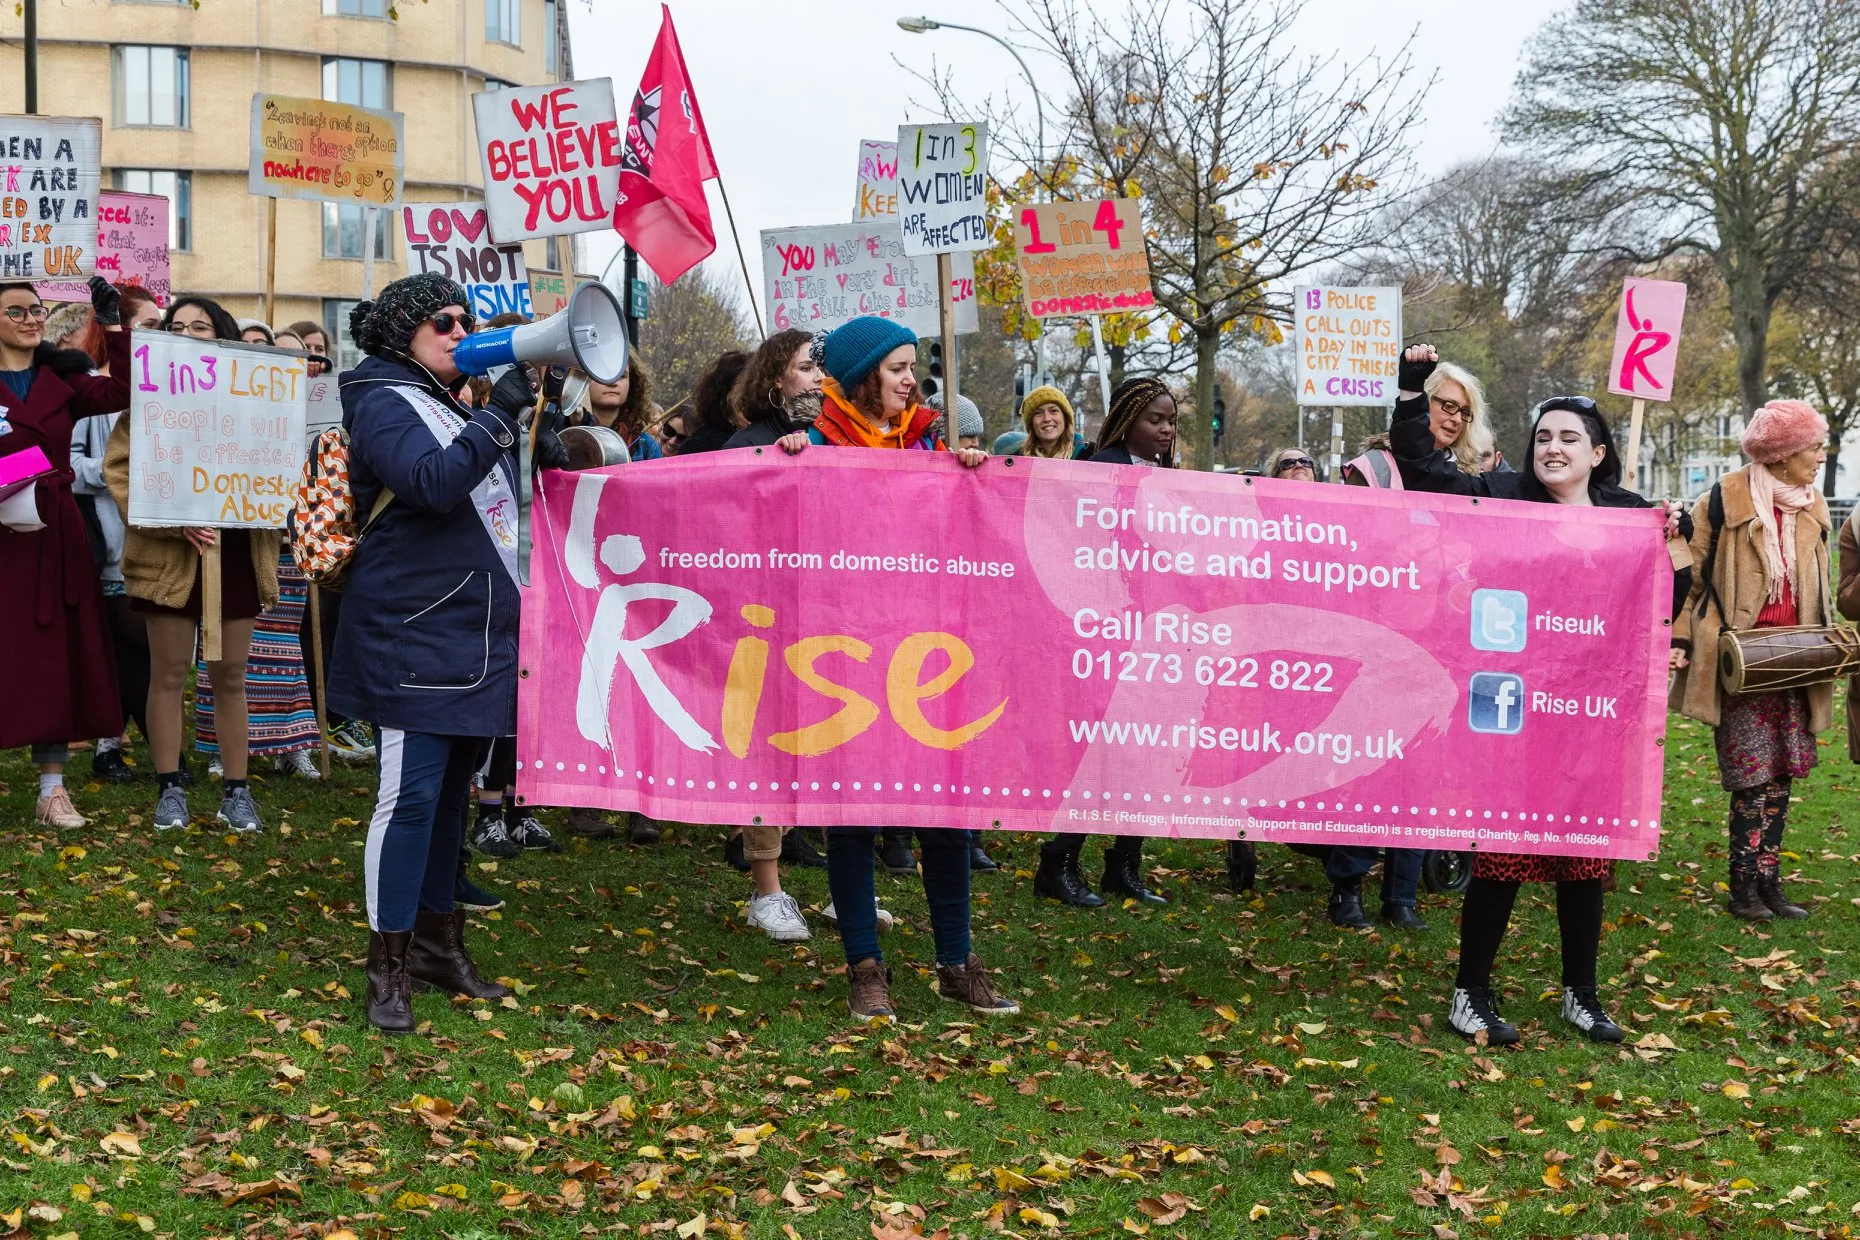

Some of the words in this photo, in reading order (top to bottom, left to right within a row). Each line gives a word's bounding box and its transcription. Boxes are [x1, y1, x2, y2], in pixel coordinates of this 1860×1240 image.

[329, 116, 352, 131] not
[355, 121, 370, 133] an
[511, 87, 578, 132] WE
[54, 139, 74, 162] A
[266, 131, 304, 152] when
[355, 133, 397, 157] option
[487, 121, 622, 181] BELIEVE
[914, 127, 922, 170] 1
[961, 125, 978, 174] 3
[30, 167, 78, 191] ARE
[264, 158, 331, 184] nowhere
[334, 164, 351, 188] to
[901, 173, 983, 204] WOMEN
[39, 196, 66, 223] BY
[73, 199, 88, 218] A
[513, 174, 610, 231] YOU
[860, 183, 898, 218] KEE
[904, 212, 926, 236] ARE
[922, 215, 987, 247] AFFECTED
[1021, 208, 1056, 254] 1
[1057, 213, 1092, 245] in
[1092, 200, 1124, 250] 4
[0, 251, 33, 277] HE
[44, 246, 82, 276] UK
[455, 245, 521, 283] NOT
[773, 279, 794, 299] in
[836, 269, 877, 293] very
[883, 260, 919, 287] dirt
[1029, 279, 1055, 299] be
[1127, 270, 1150, 293] by
[859, 291, 891, 314] like
[1306, 289, 1321, 310] 13
[1327, 290, 1377, 311] POLICE
[1305, 315, 1345, 333] CALL
[1349, 318, 1391, 337] OUTS
[1305, 337, 1314, 352] A
[1318, 337, 1346, 353] DAY
[1351, 340, 1367, 355] IN
[1371, 342, 1397, 357] THE
[134, 344, 159, 392] 1
[1348, 357, 1382, 376] THIS
[1384, 360, 1397, 376] IS
[1303, 378, 1316, 395] A
[1326, 376, 1384, 398] CRISIS
[144, 401, 235, 441] People
[251, 416, 288, 441] will
[154, 434, 183, 463] be
[198, 442, 297, 467] affected
[142, 462, 174, 499] by
[193, 466, 301, 500] Domestic
[220, 495, 288, 525] Abus
[1076, 498, 1136, 530] For
[1147, 503, 1358, 552] information,
[659, 547, 761, 569] freedom
[768, 548, 822, 569] from
[829, 549, 939, 574] domestic
[946, 555, 1015, 578] abuse
[1074, 541, 1195, 575] advice
[1206, 551, 1271, 580] and
[1282, 557, 1421, 593] support
[1073, 607, 1142, 641] Call
[1155, 612, 1232, 645] Rise
[1535, 610, 1606, 637] riseuk
[576, 582, 1009, 760] Rise
[1072, 648, 1183, 684] 01273
[1195, 655, 1258, 688] 622
[1269, 659, 1333, 693] 822
[1532, 690, 1579, 716] Rise
[1585, 696, 1617, 719] UK
[1068, 718, 1404, 765] www.riseuk.org.uk
[1069, 808, 1112, 821] R.I.S.E
[1115, 811, 1168, 826] (Refuge,
[1171, 813, 1244, 828] Information,
[1248, 817, 1297, 832] Support
[1299, 823, 1321, 832] and
[1325, 821, 1389, 836] Education)
[1392, 826, 1401, 835] is
[1404, 828, 1413, 836] a
[1415, 827, 1475, 841] registered
[1524, 830, 1541, 844] Reg.
[1544, 832, 1561, 843] No.
[1565, 833, 1609, 846] 1065846
